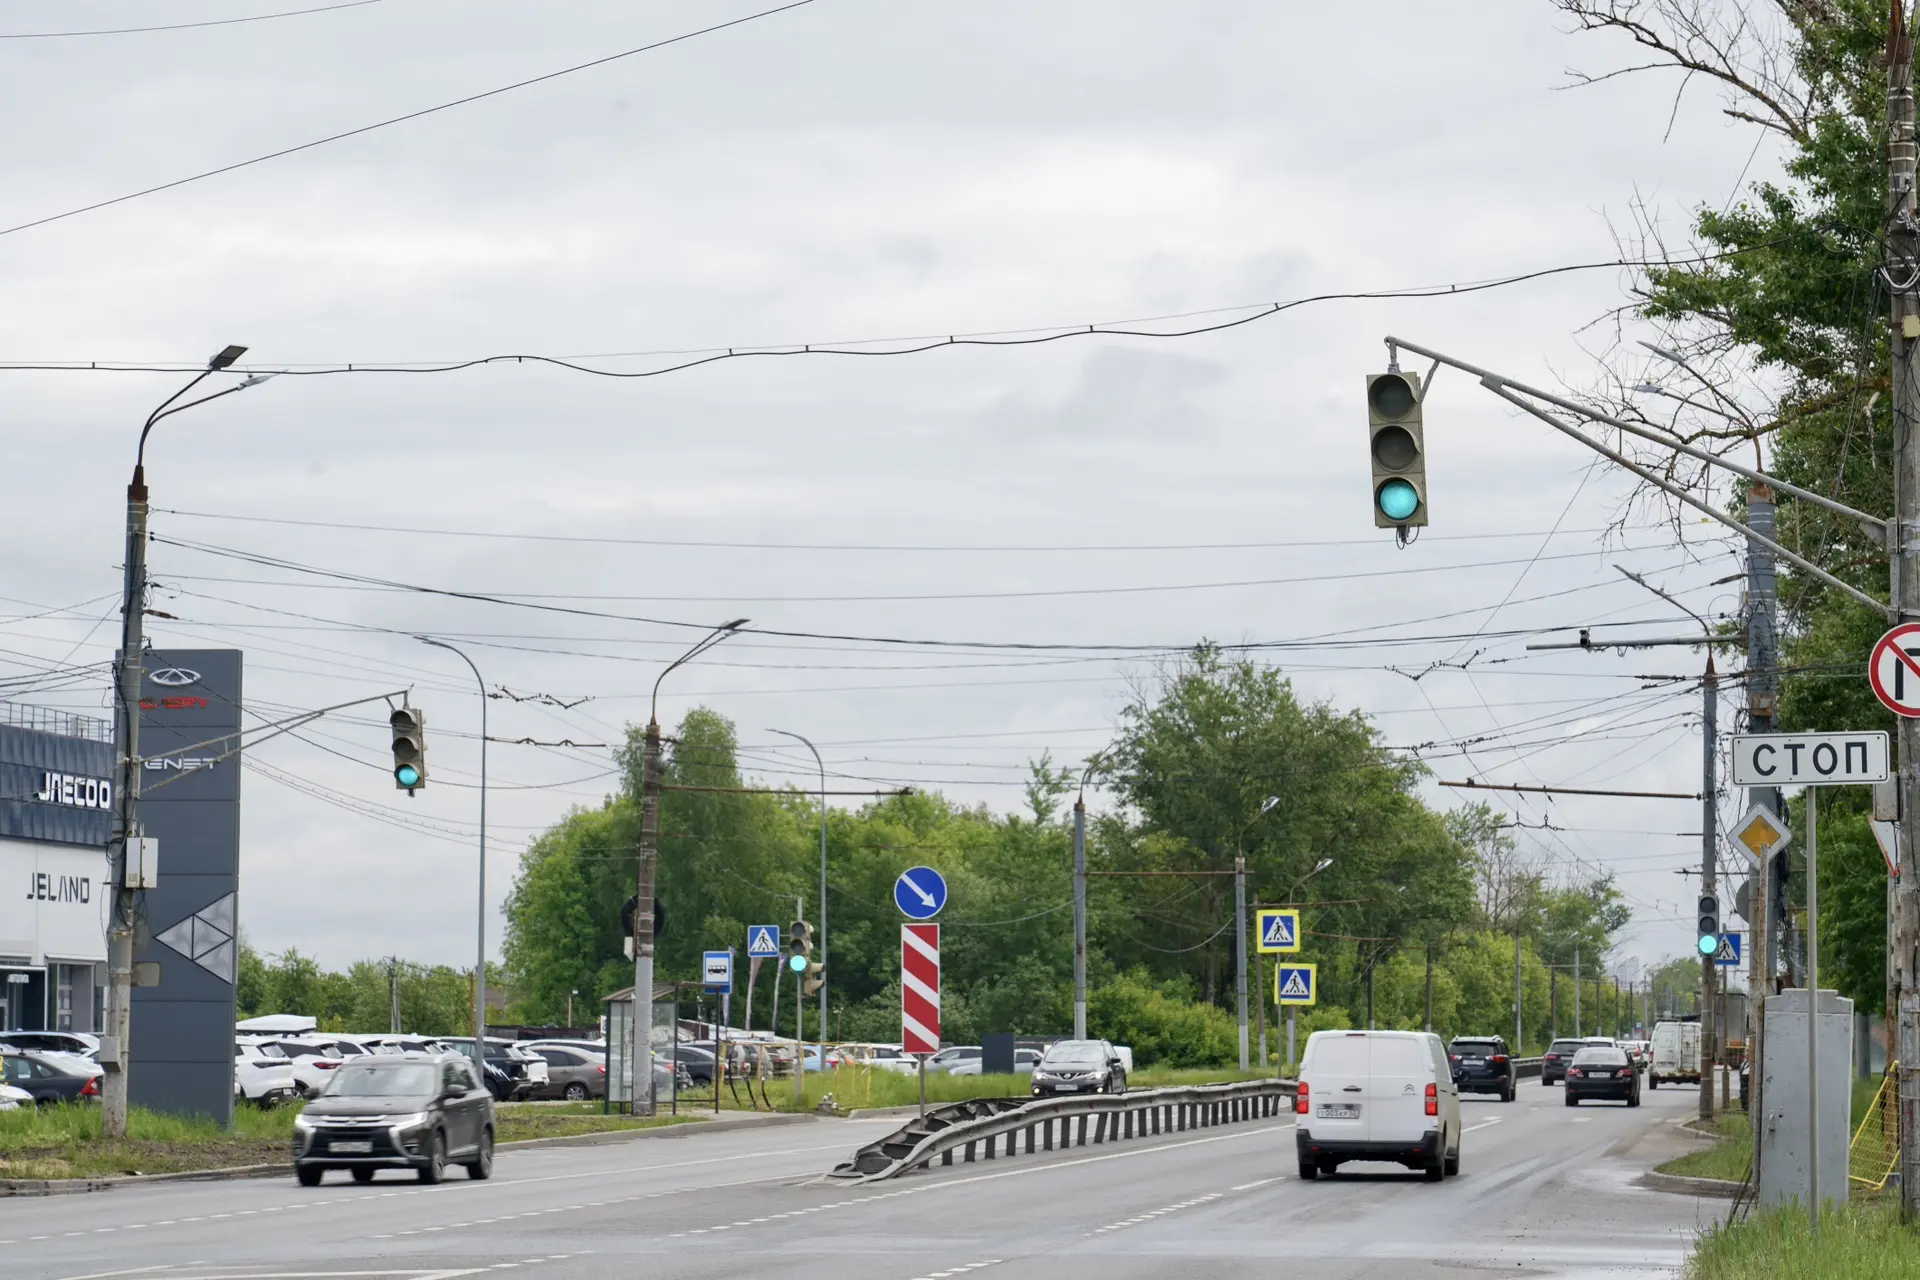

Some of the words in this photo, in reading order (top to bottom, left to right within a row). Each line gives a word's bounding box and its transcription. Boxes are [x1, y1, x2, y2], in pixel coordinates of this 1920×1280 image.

[1752, 741, 1868, 776] СТОП
[37, 771, 111, 809] JAECOO
[26, 872, 90, 904] JELAND
